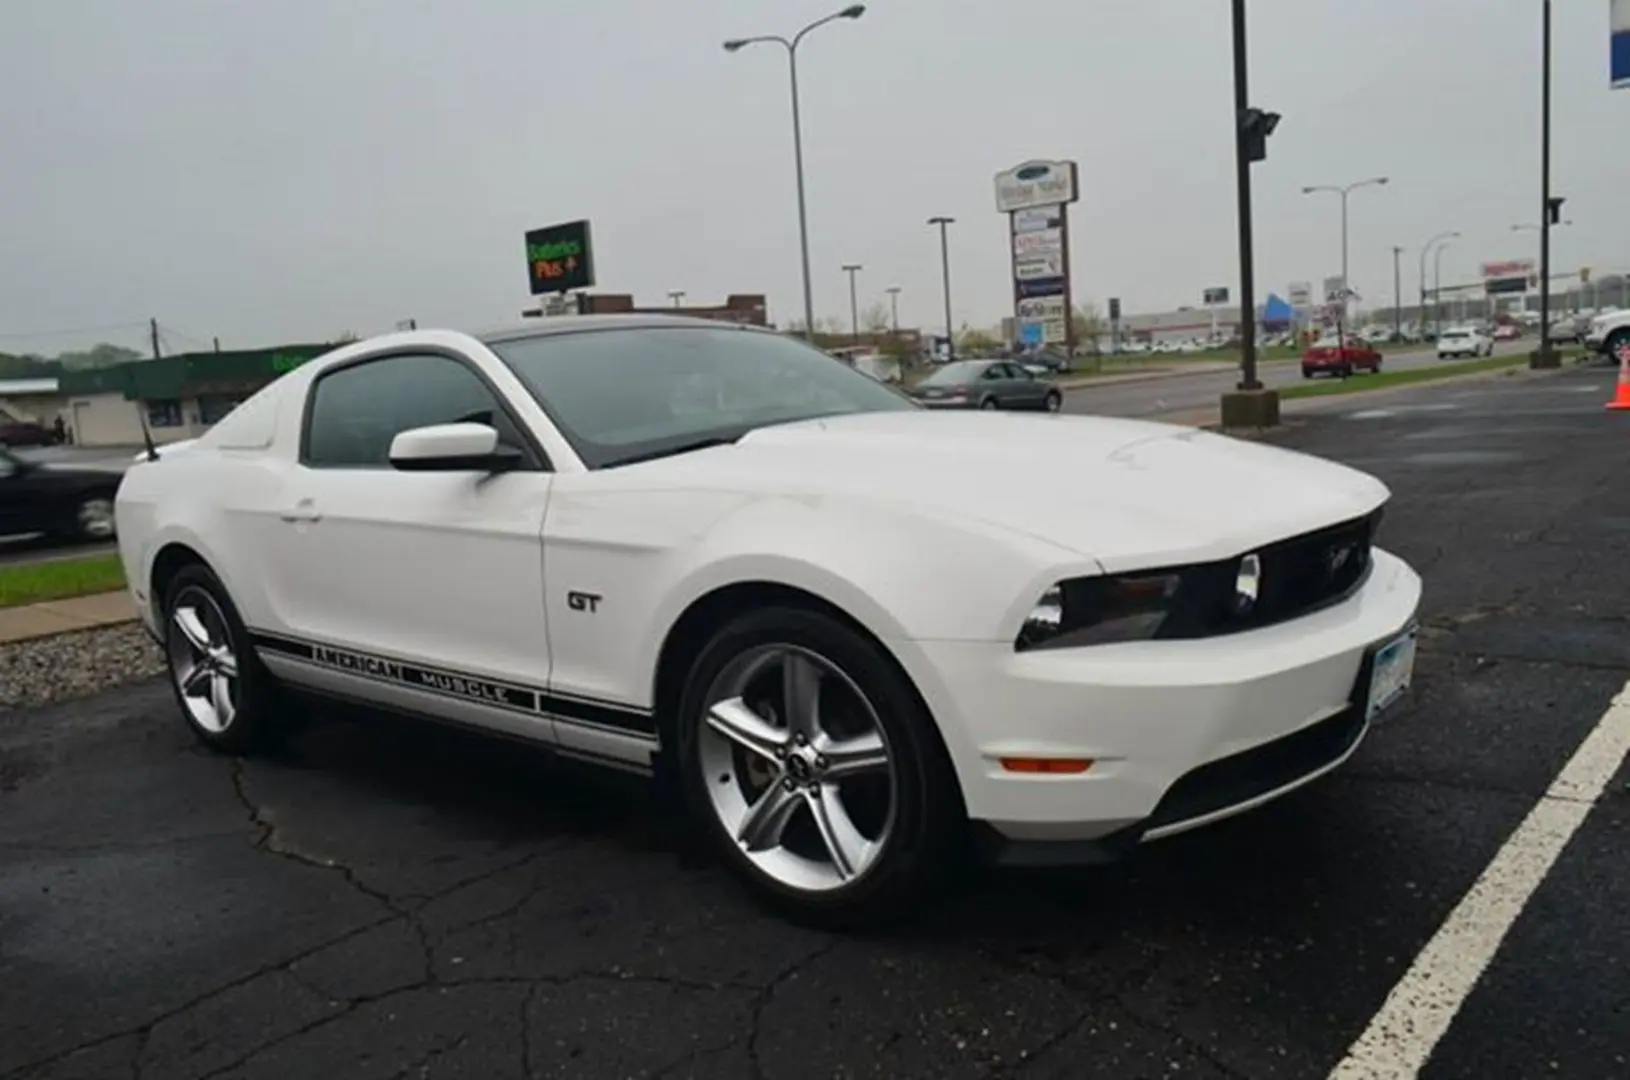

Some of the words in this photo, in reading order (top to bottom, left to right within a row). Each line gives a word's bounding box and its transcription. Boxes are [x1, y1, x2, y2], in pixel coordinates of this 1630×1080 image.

[567, 590, 602, 614] GT
[313, 645, 403, 681] AMERICAN
[421, 671, 508, 702] MUSCLE
